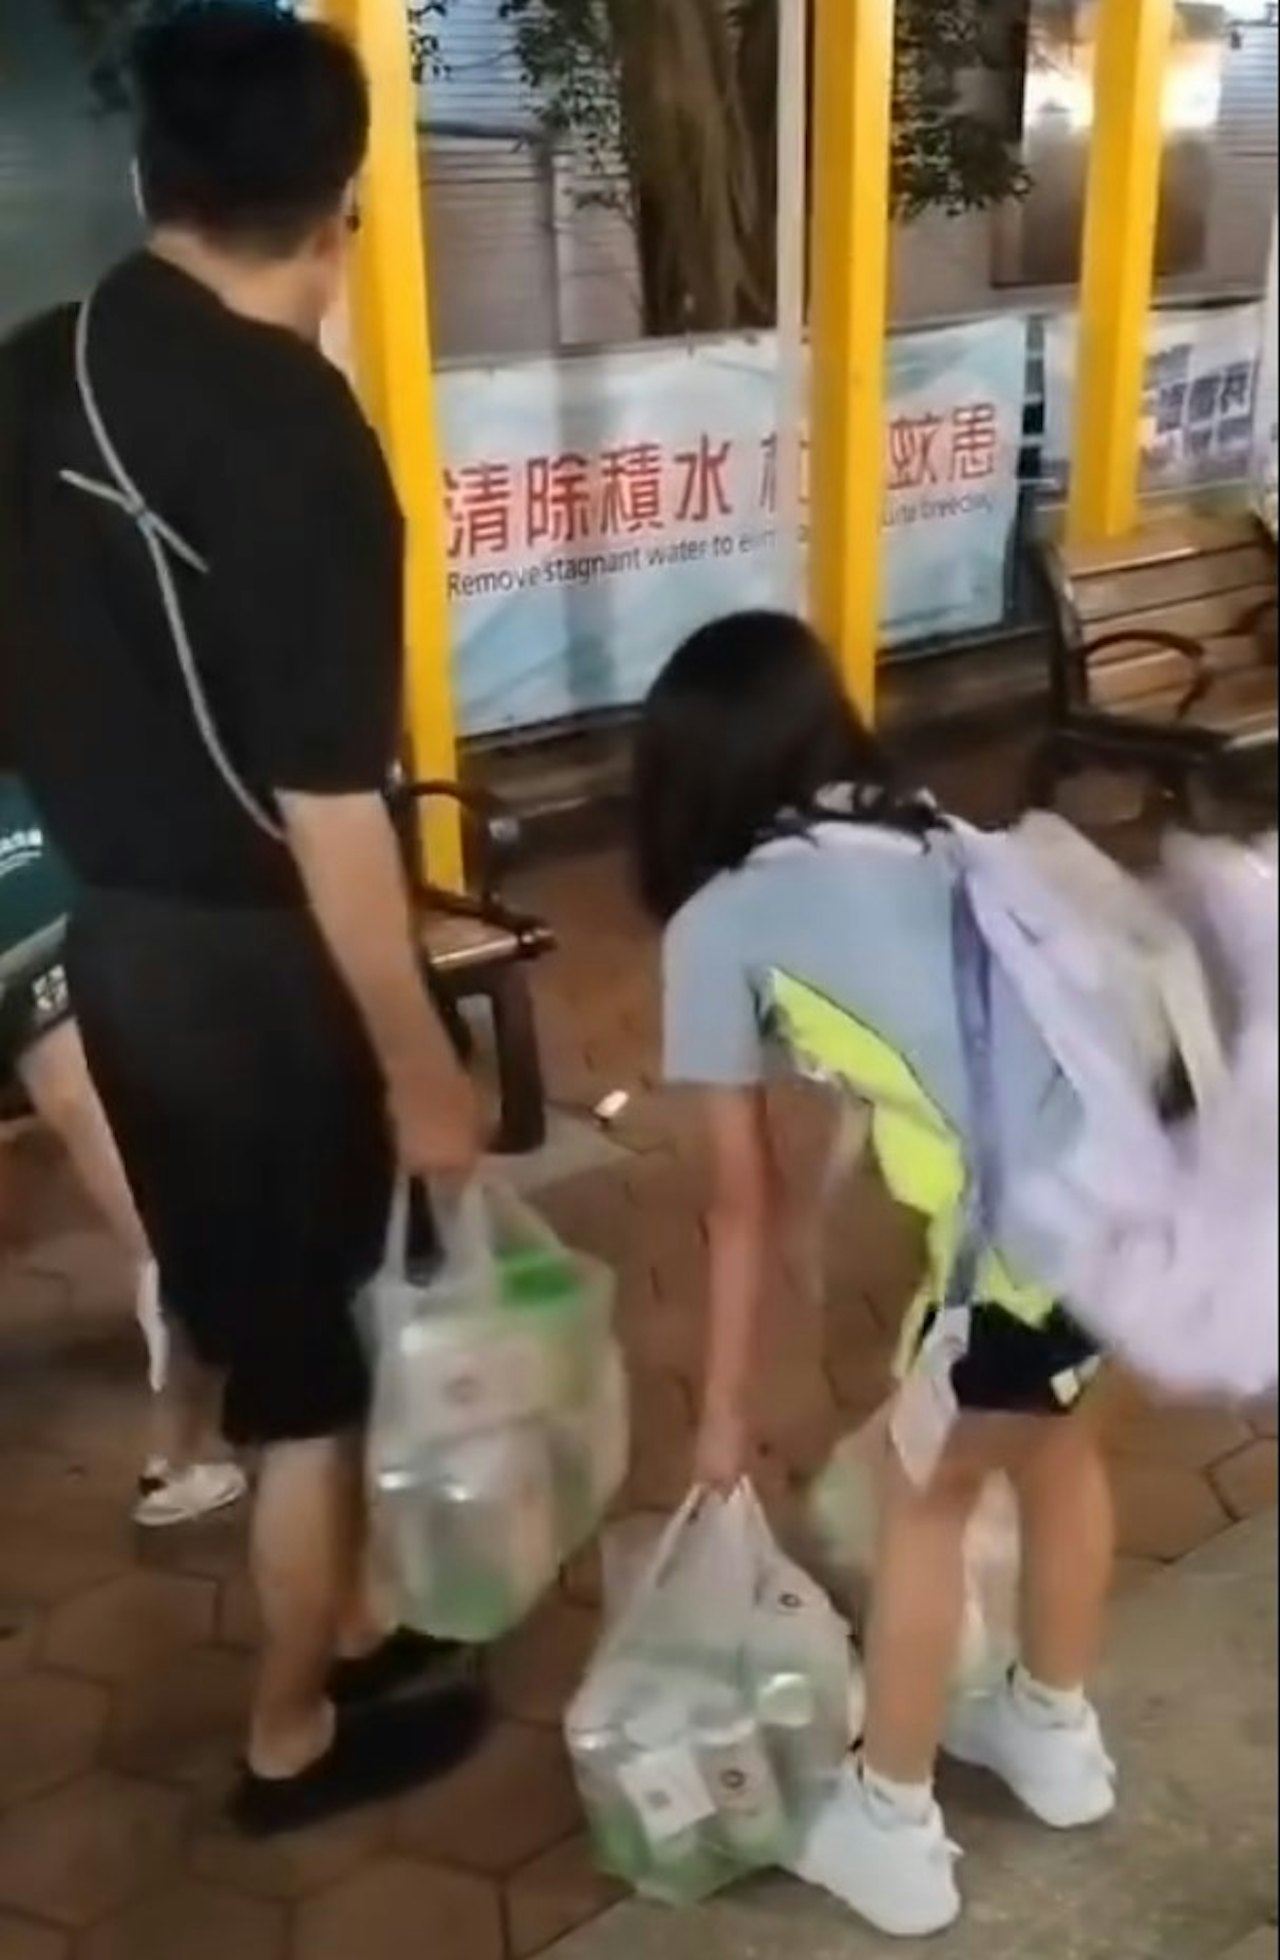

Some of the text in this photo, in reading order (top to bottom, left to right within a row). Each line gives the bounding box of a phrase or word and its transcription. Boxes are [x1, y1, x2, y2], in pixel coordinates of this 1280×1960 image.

[442, 431, 734, 559] 清除積水
[447, 566, 541, 600] Remove
[544, 548, 640, 584] stagnant
[645, 539, 707, 566] water
[713, 535, 734, 557] to
